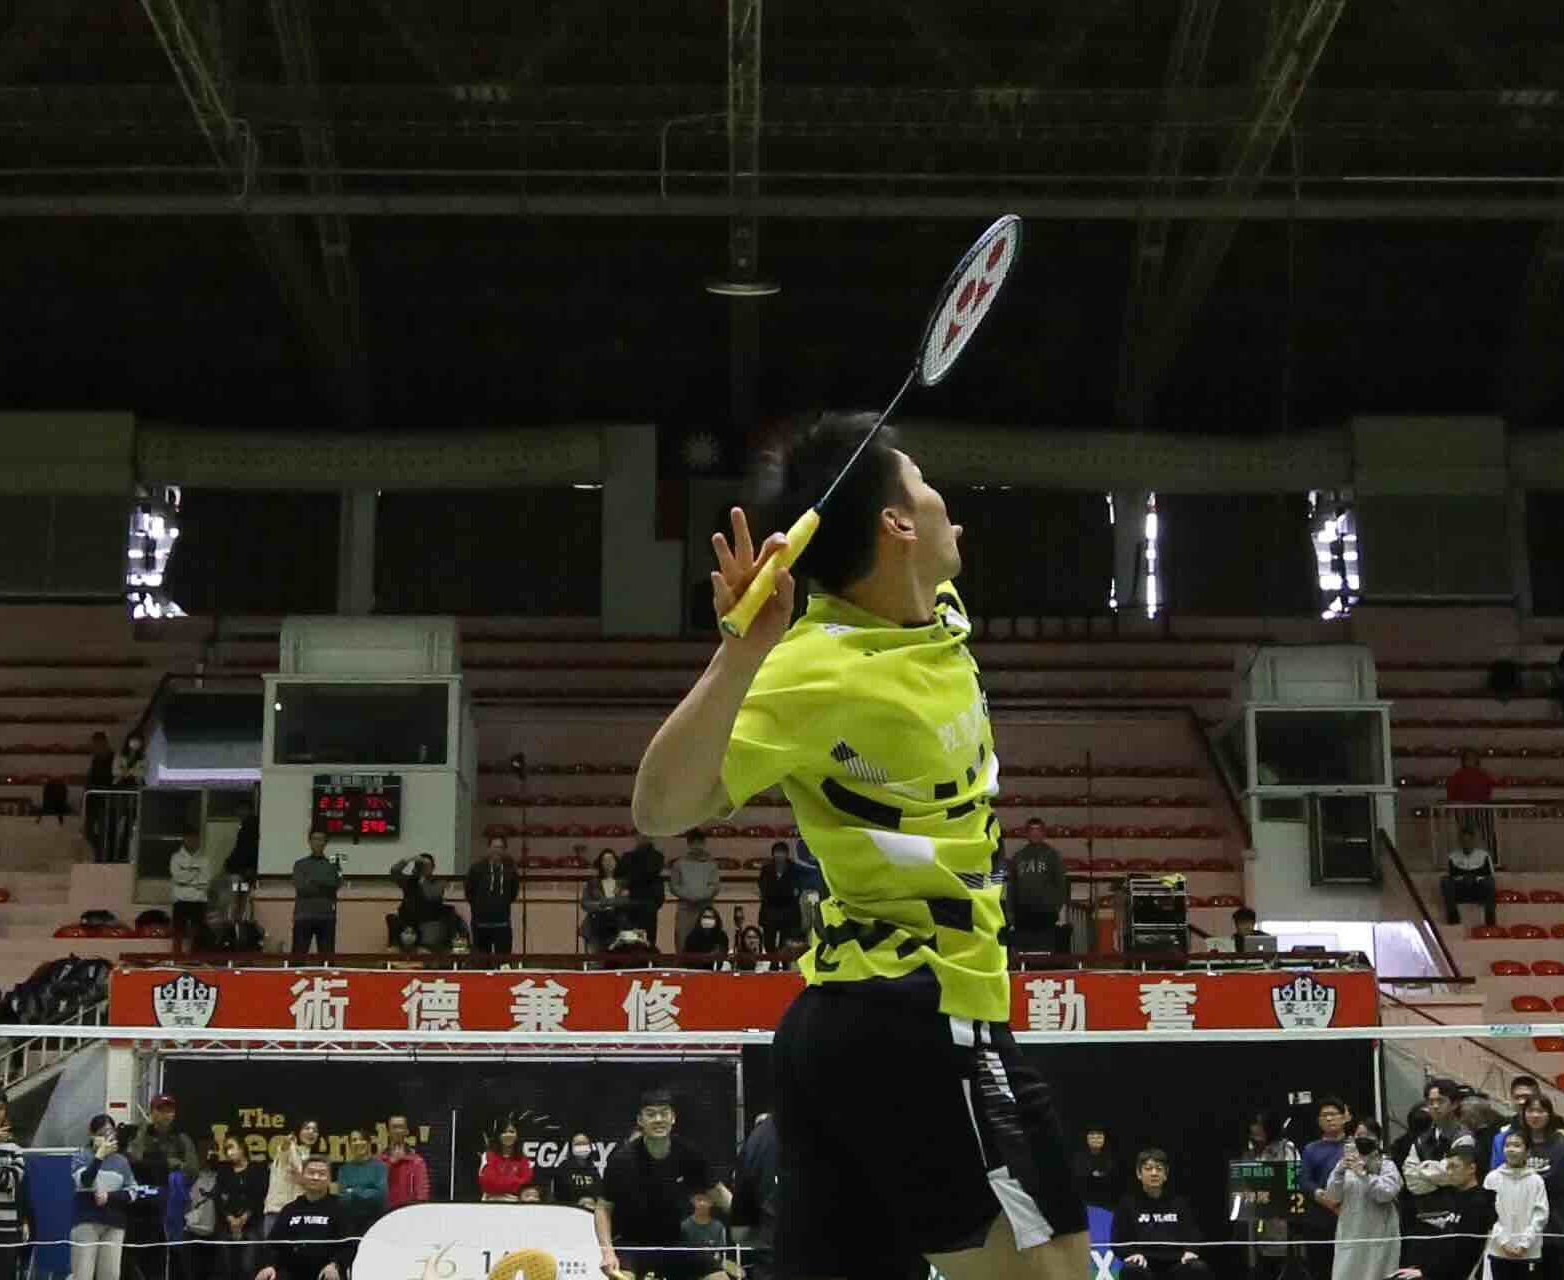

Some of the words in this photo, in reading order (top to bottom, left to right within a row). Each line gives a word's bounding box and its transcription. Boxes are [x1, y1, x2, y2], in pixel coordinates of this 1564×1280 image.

[289, 977, 682, 1031] 術德兼修
[238, 1107, 286, 1128] The
